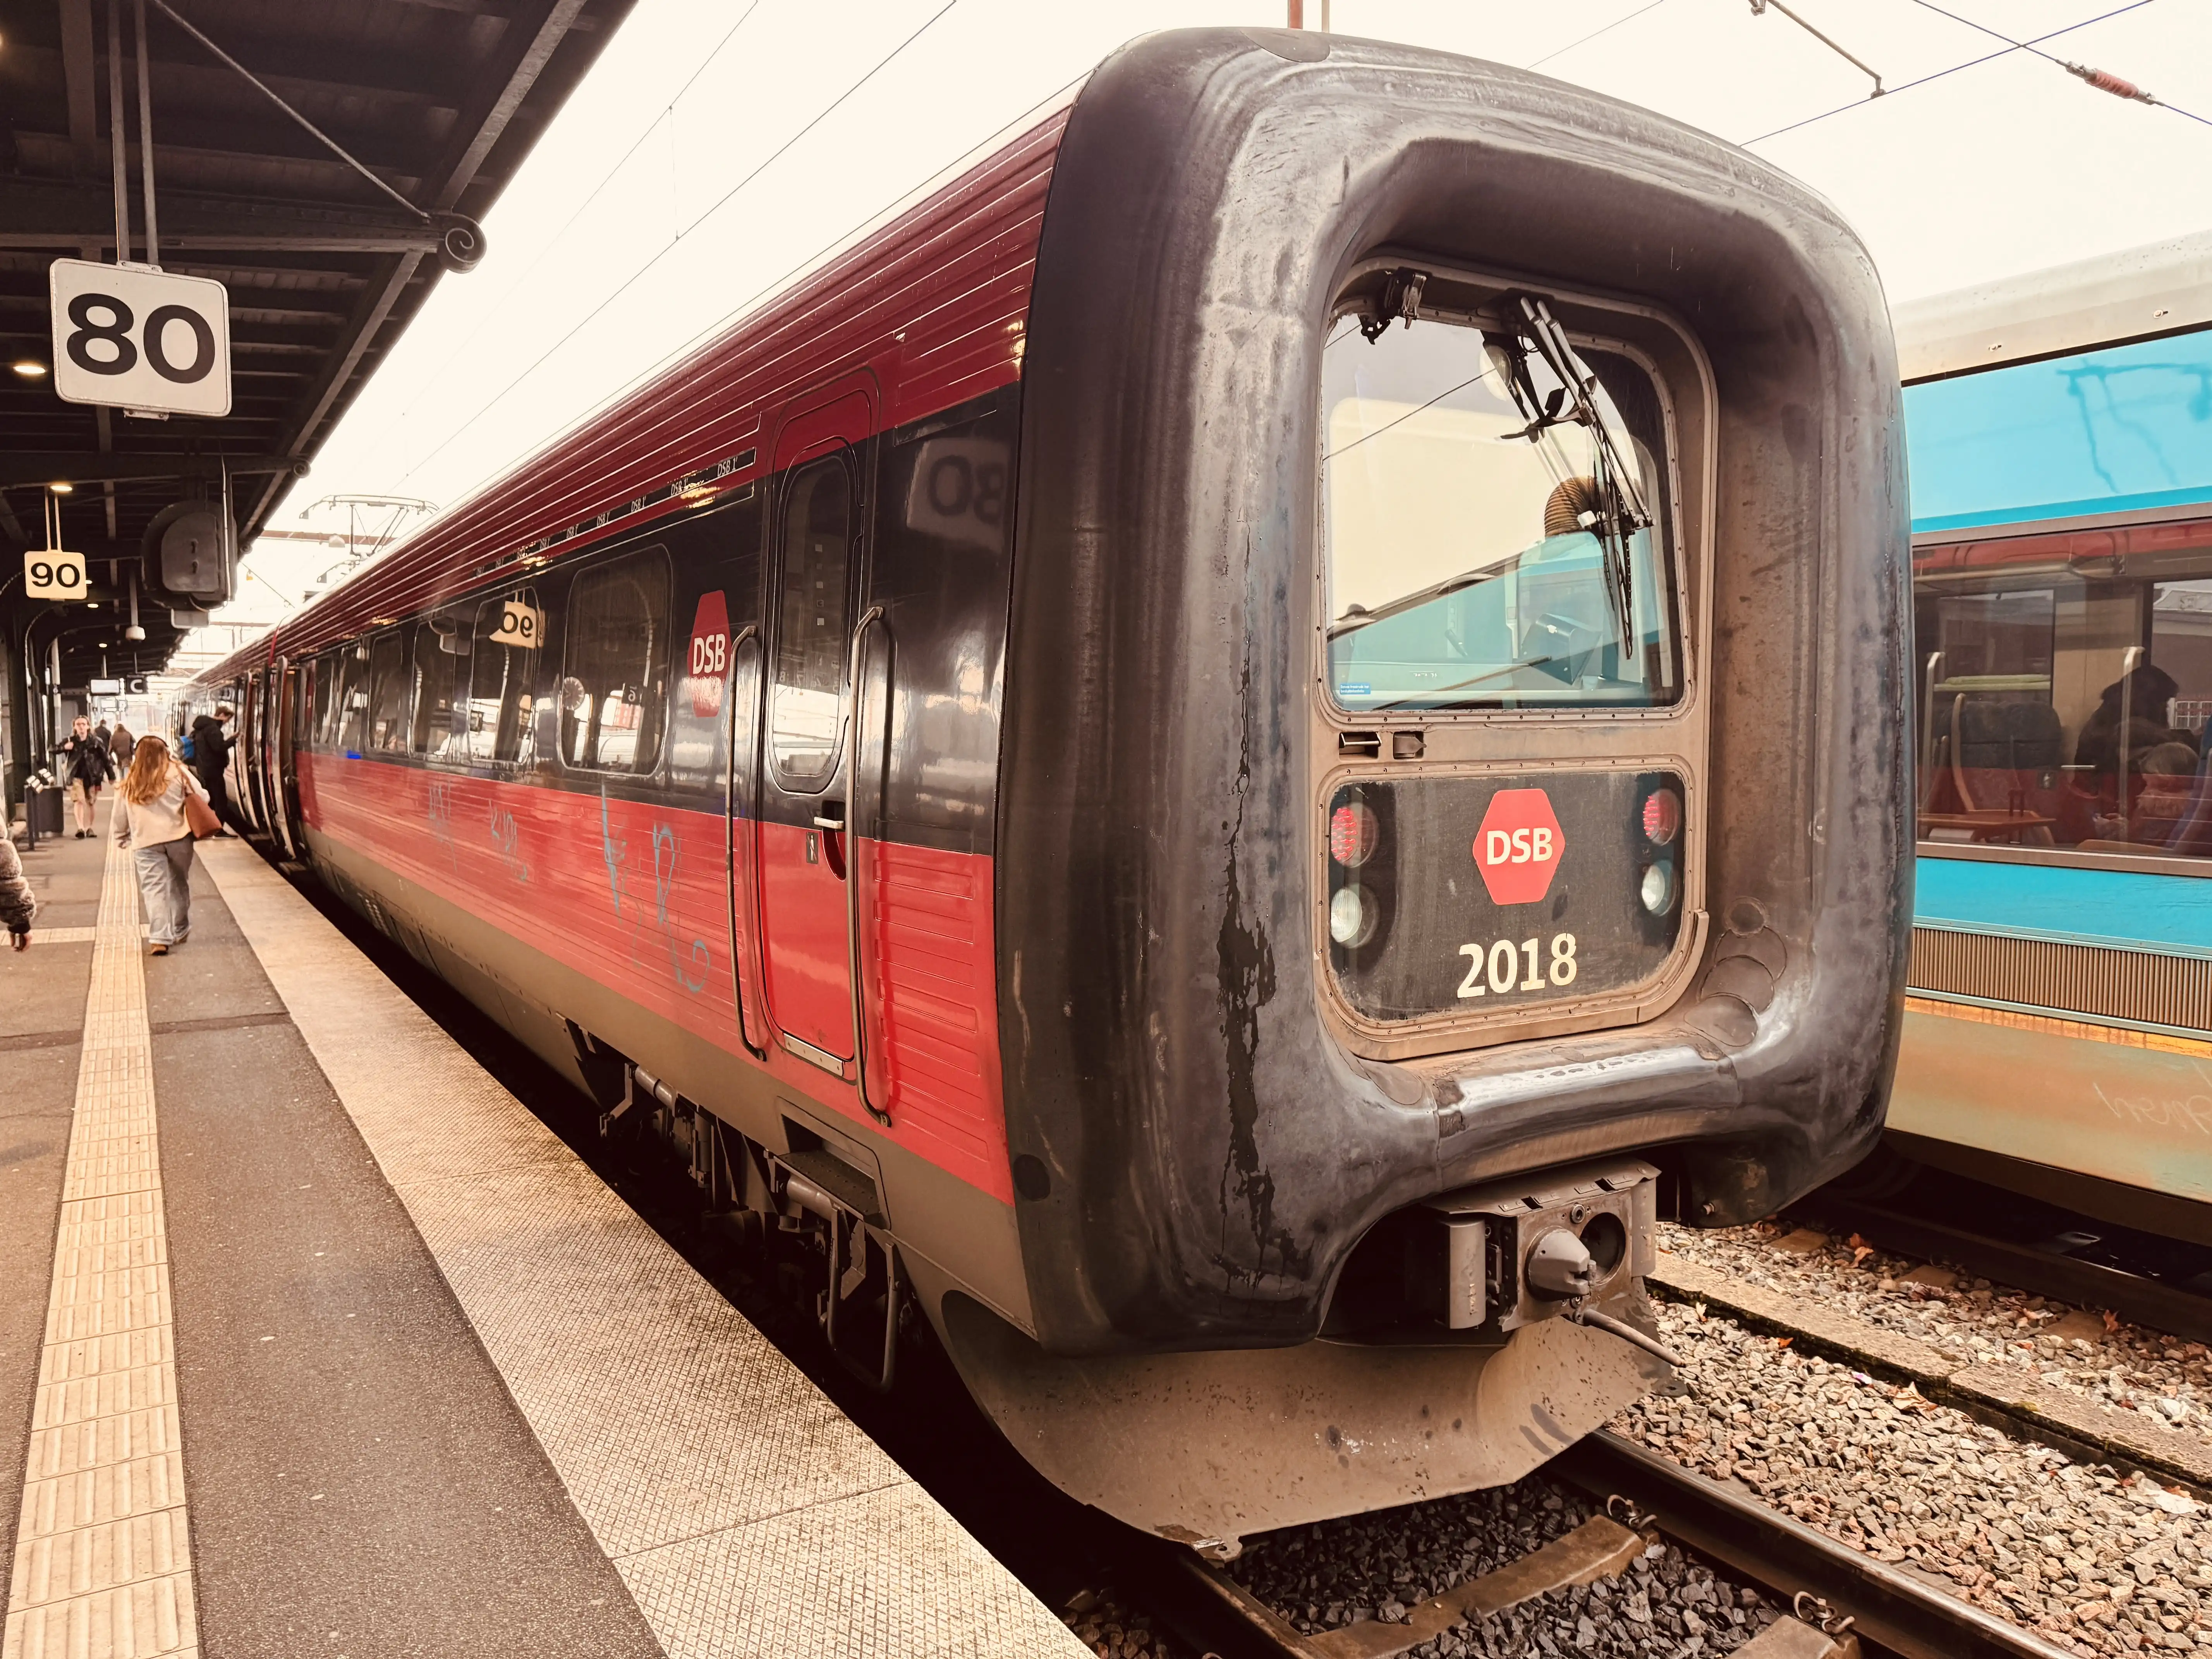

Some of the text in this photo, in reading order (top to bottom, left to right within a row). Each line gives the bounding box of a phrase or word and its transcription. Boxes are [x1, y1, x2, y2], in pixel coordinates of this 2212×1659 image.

[67, 293, 215, 383] 80
[717, 460, 731, 477] DSB
[671, 481, 682, 496] DSB
[631, 498, 641, 512] DSB
[597, 513, 605, 527] DSB
[31, 562, 80, 588] 90
[693, 634, 725, 674] DSB
[130, 679, 143, 693] C
[1487, 827, 1553, 865] DSB
[1457, 933, 1577, 998] 2018
